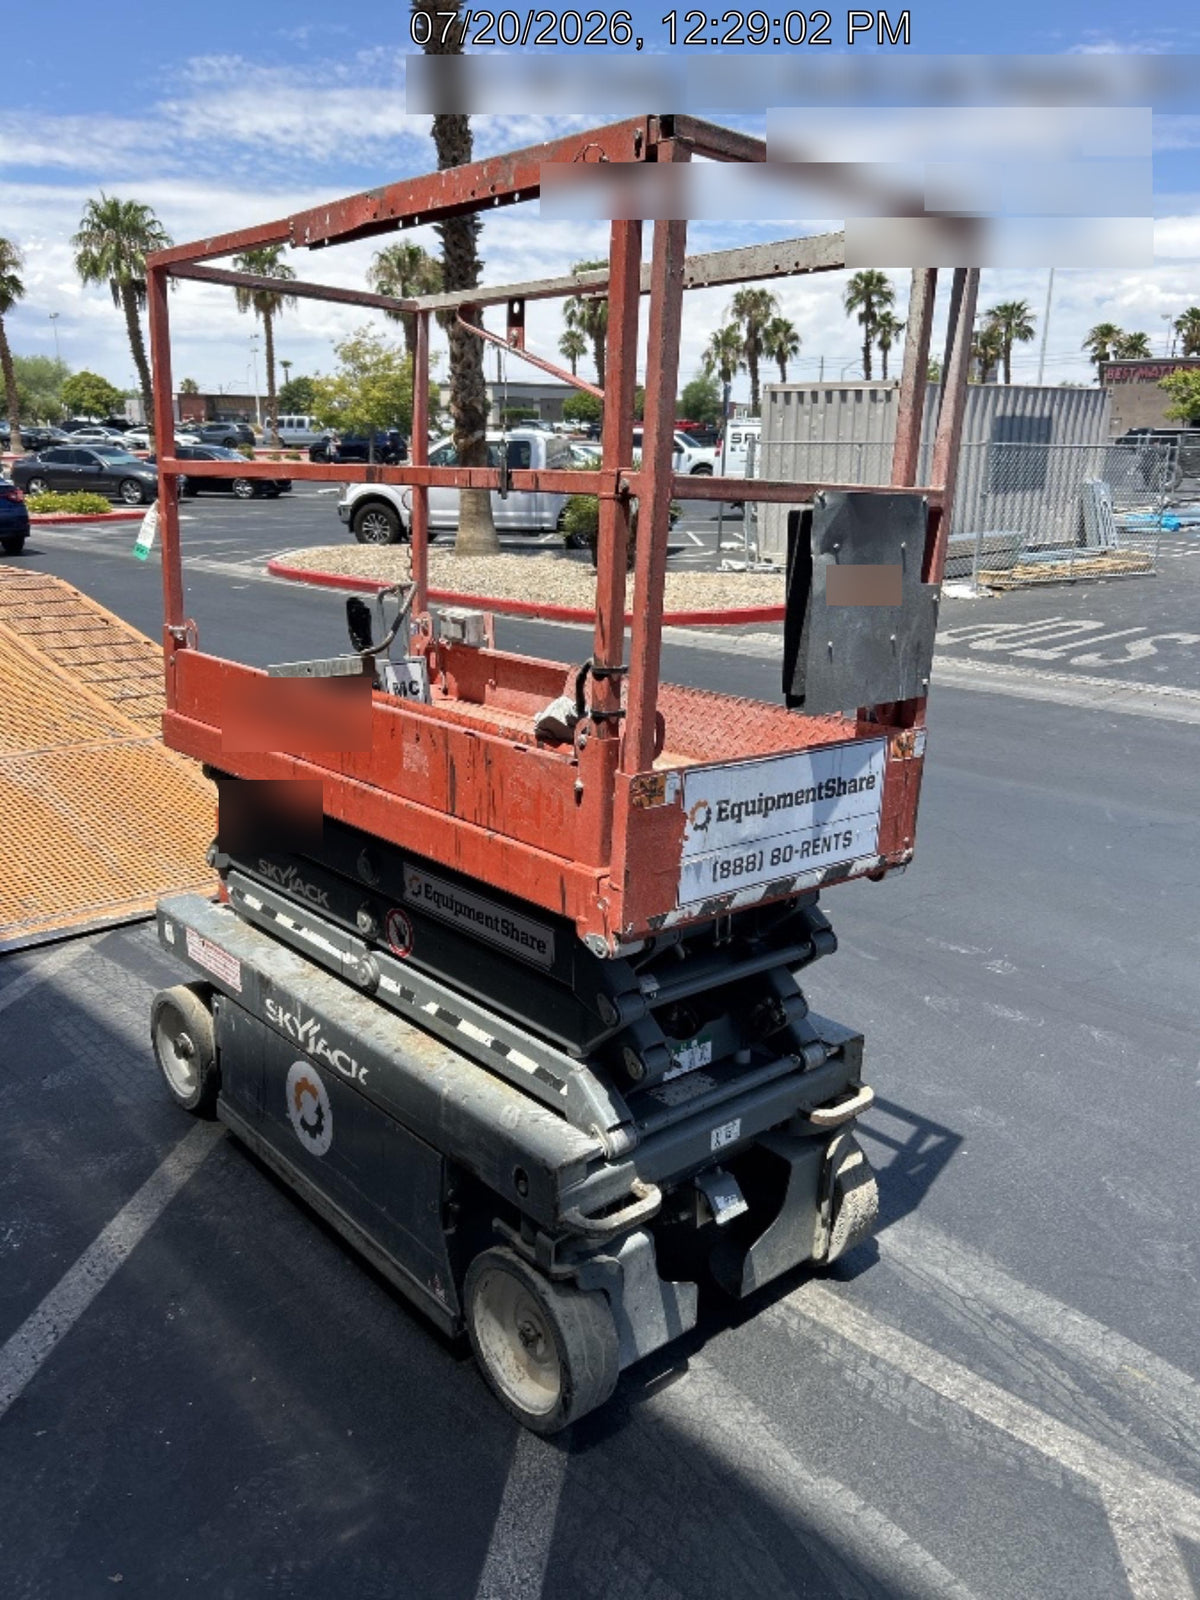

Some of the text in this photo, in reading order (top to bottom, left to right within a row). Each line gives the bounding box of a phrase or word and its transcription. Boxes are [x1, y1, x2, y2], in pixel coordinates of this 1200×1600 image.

[1107, 366, 1137, 380] BEST
[716, 772, 876, 825] EquipmentShare
[712, 830, 853, 883] (888) 80-RENTS
[258, 858, 331, 909] SKYJACK
[423, 882, 548, 955] EquipmentShare
